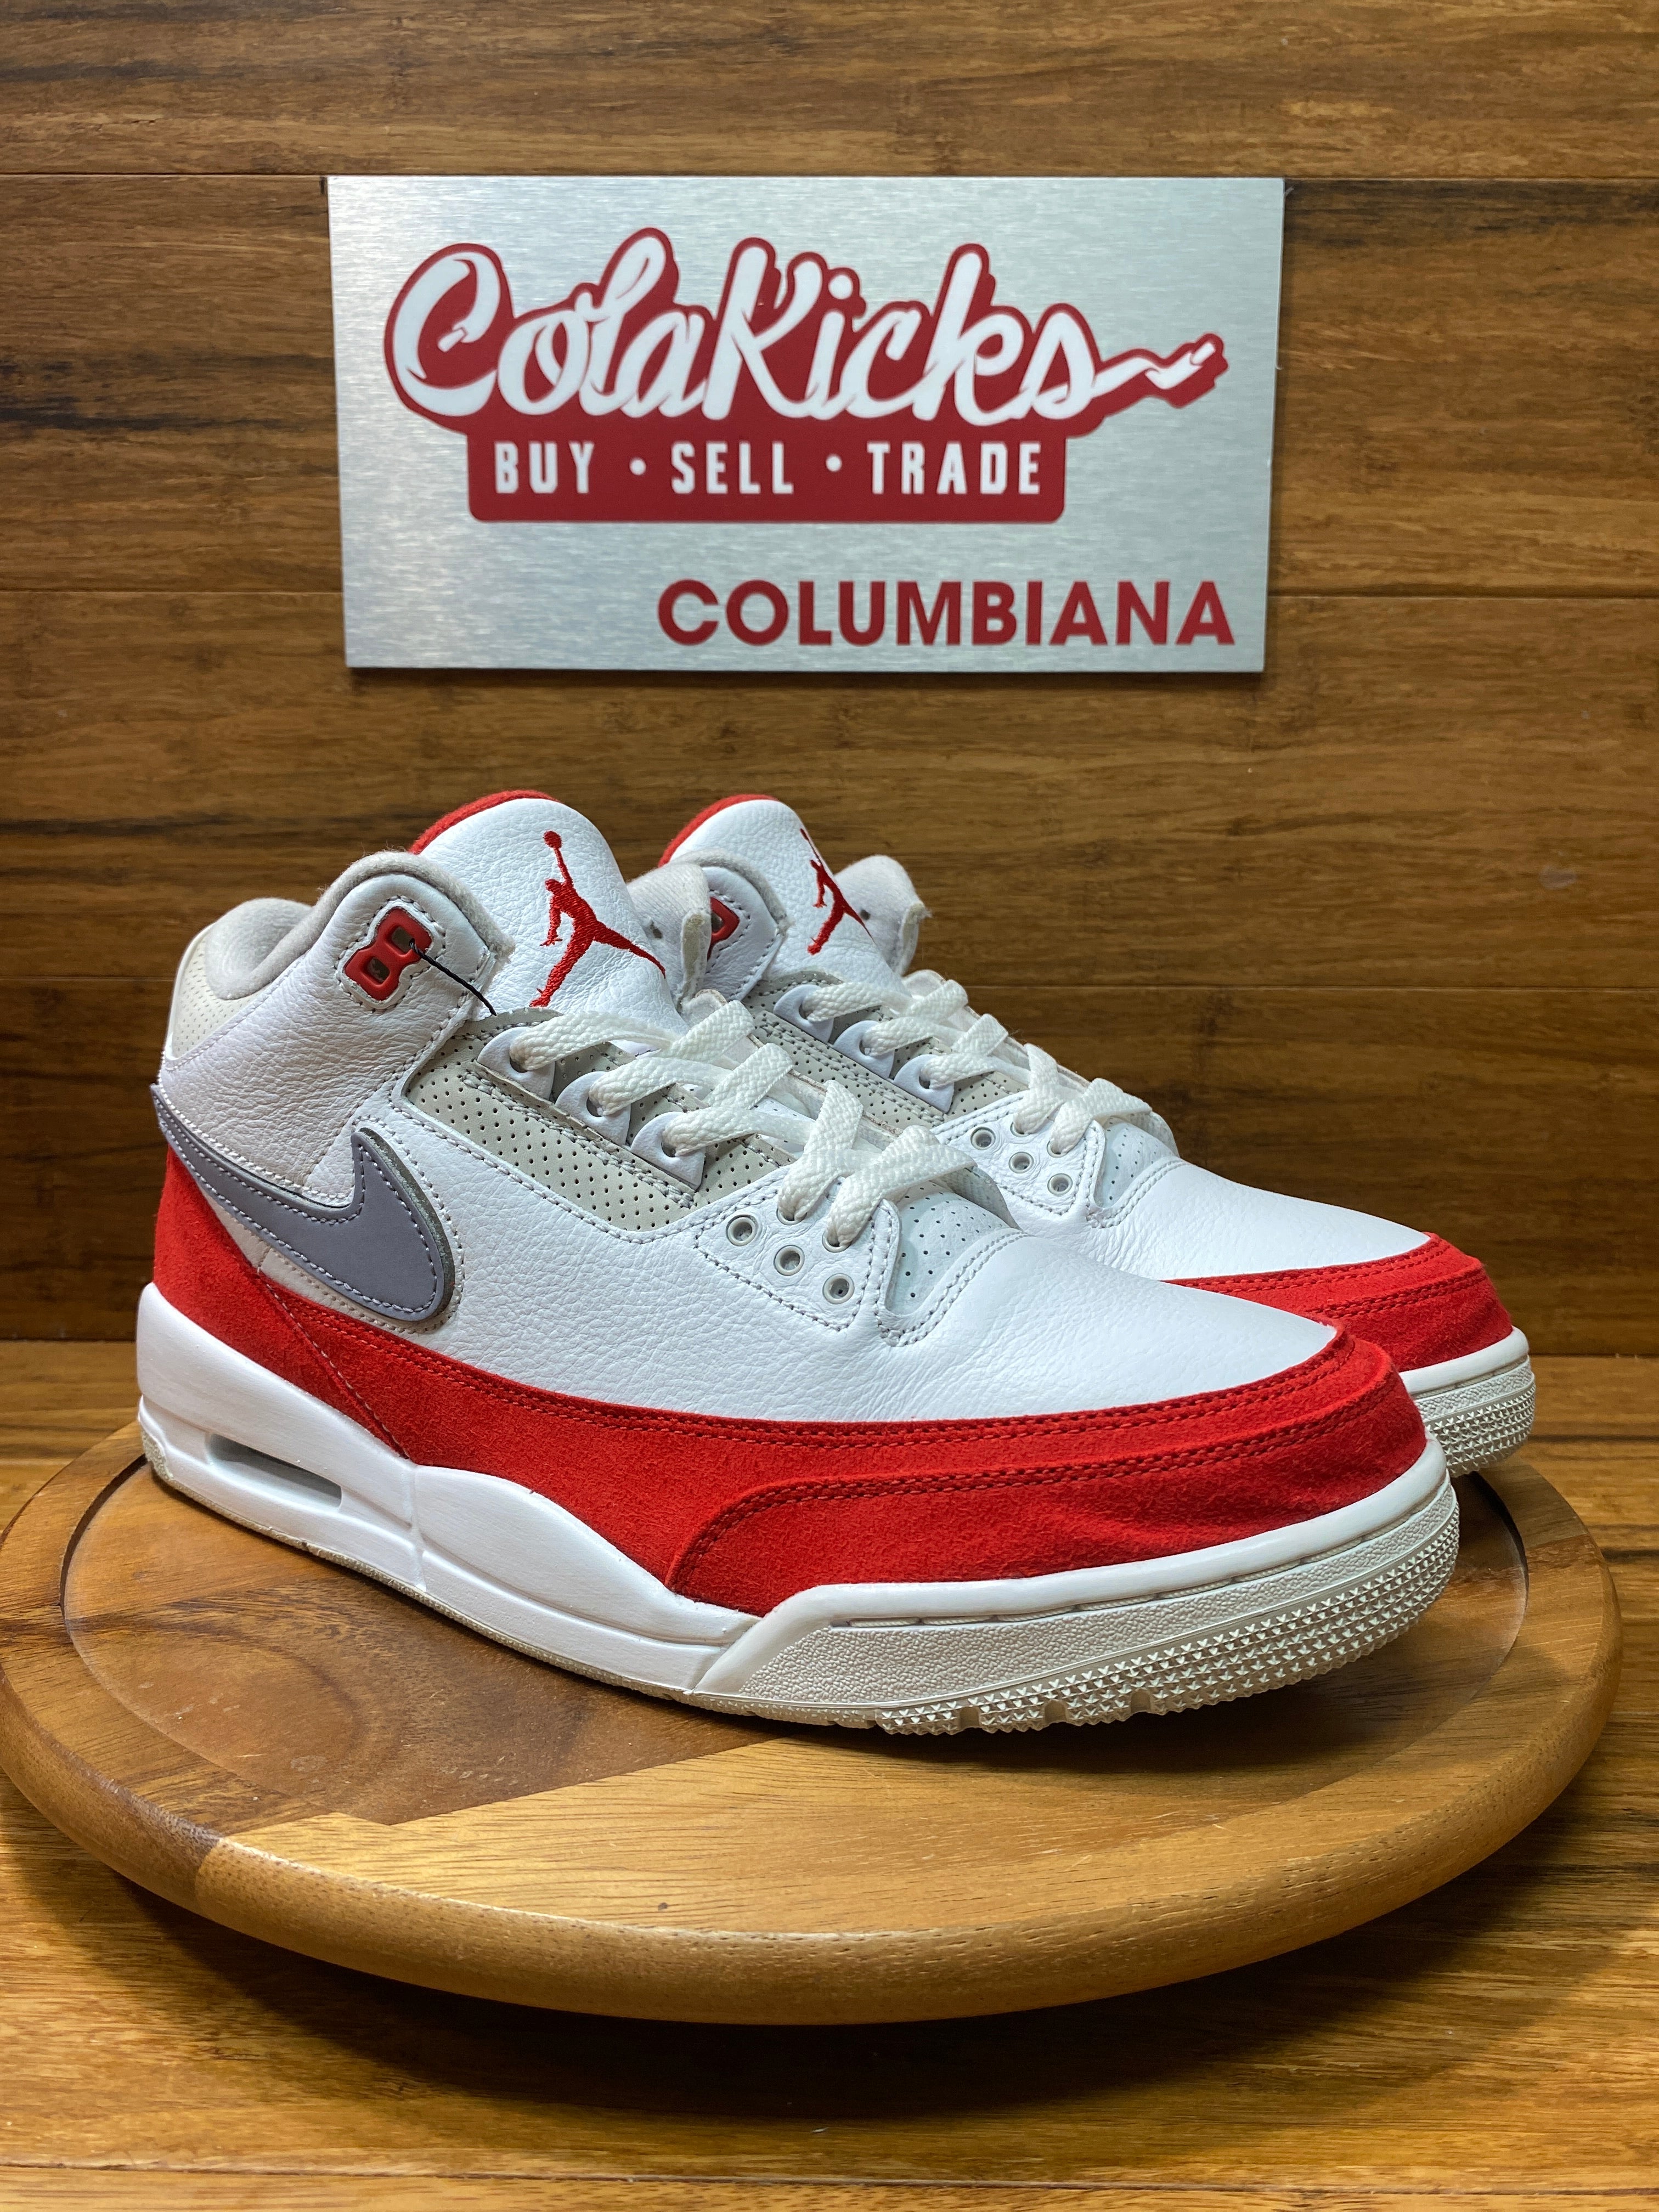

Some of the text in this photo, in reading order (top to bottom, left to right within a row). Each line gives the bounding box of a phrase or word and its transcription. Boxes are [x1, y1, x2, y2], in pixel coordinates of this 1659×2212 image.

[393, 236, 1216, 426] ColaKicks
[495, 442, 1041, 494] BUY SELL TRADE
[659, 579, 1233, 645] COLUMBIANA
